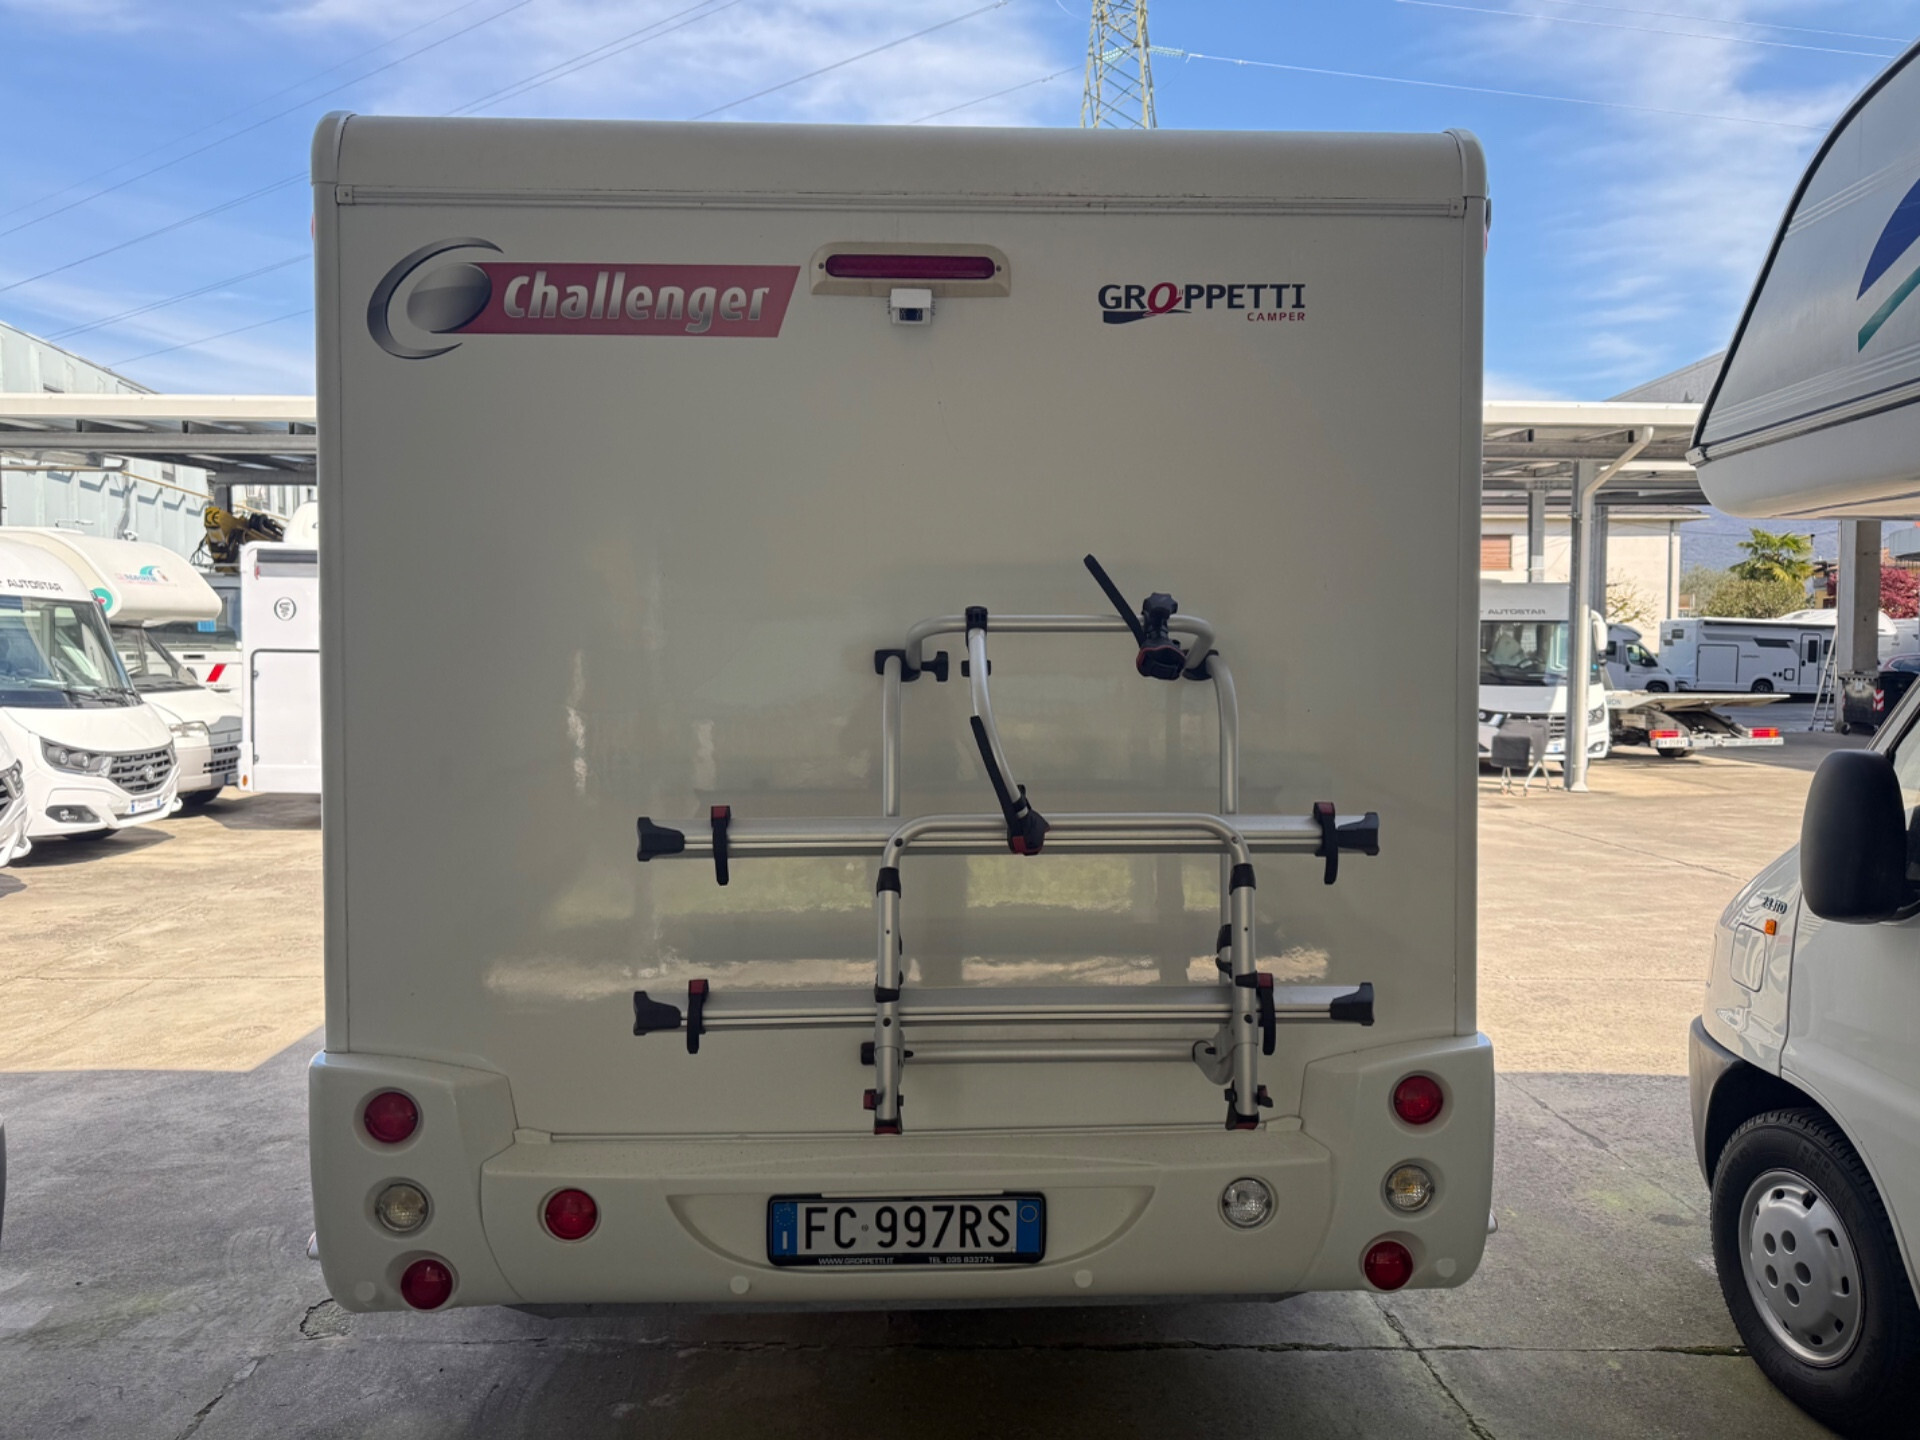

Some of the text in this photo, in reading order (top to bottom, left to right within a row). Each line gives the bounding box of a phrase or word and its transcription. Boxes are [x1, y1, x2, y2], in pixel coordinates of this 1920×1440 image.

[503, 271, 770, 334] Challenger
[1098, 282, 1306, 313] GROPPETTI
[1247, 312, 1306, 322] CAMPER
[805, 1205, 1010, 1249] FC 997RS
[818, 1257, 894, 1265] WWW.GROPPETTI.IT
